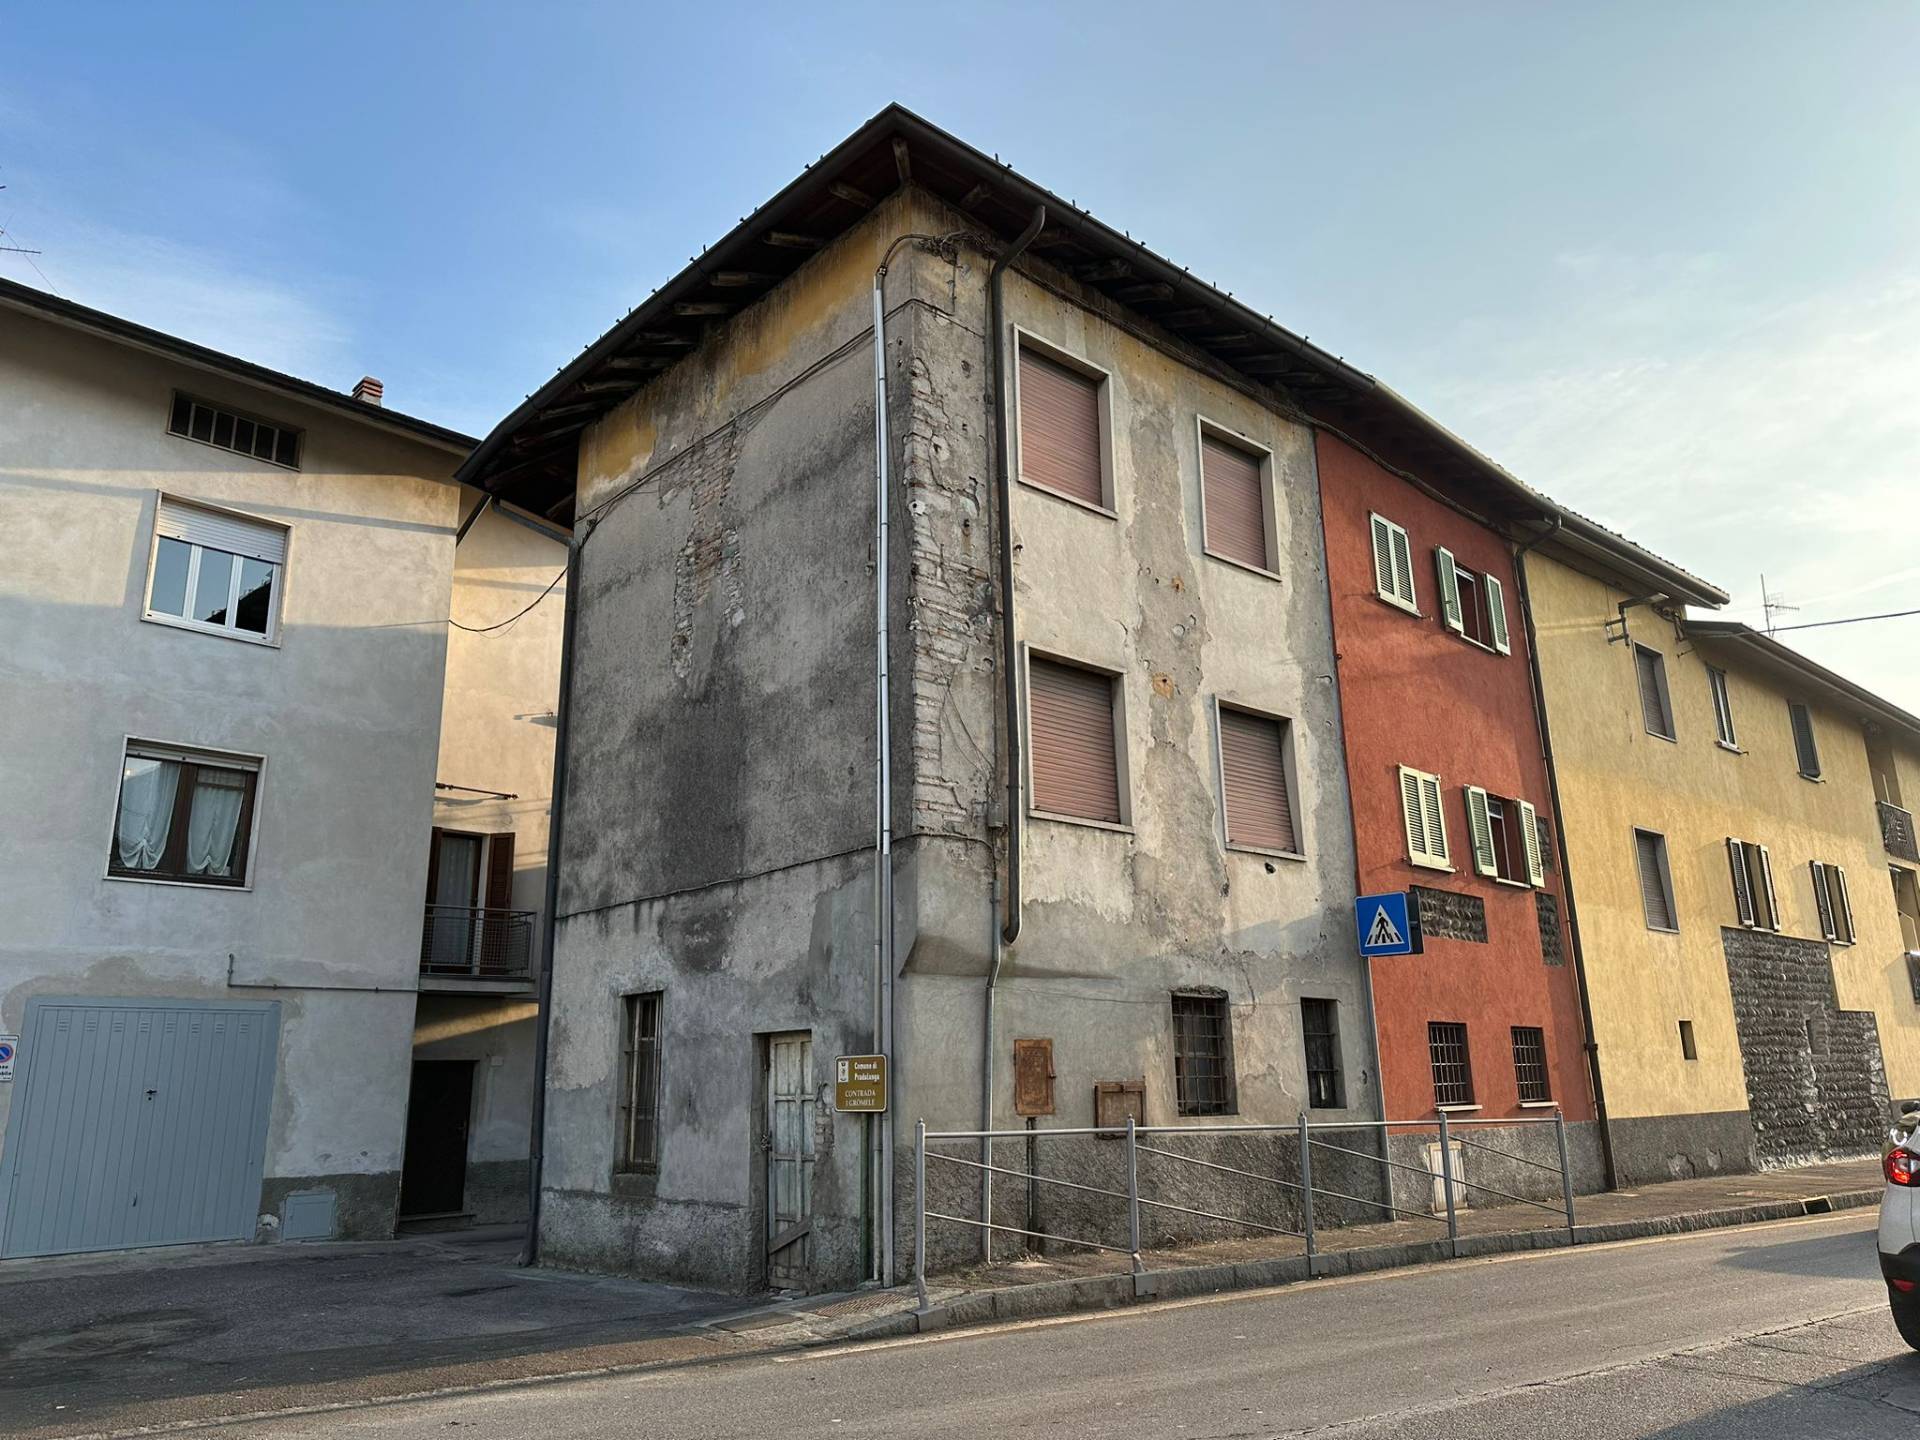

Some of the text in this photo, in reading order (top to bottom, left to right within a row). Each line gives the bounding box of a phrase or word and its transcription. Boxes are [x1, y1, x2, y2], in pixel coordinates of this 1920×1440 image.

[854, 1061, 878, 1070] Comune di
[844, 1089, 876, 1098] CONTRADA
